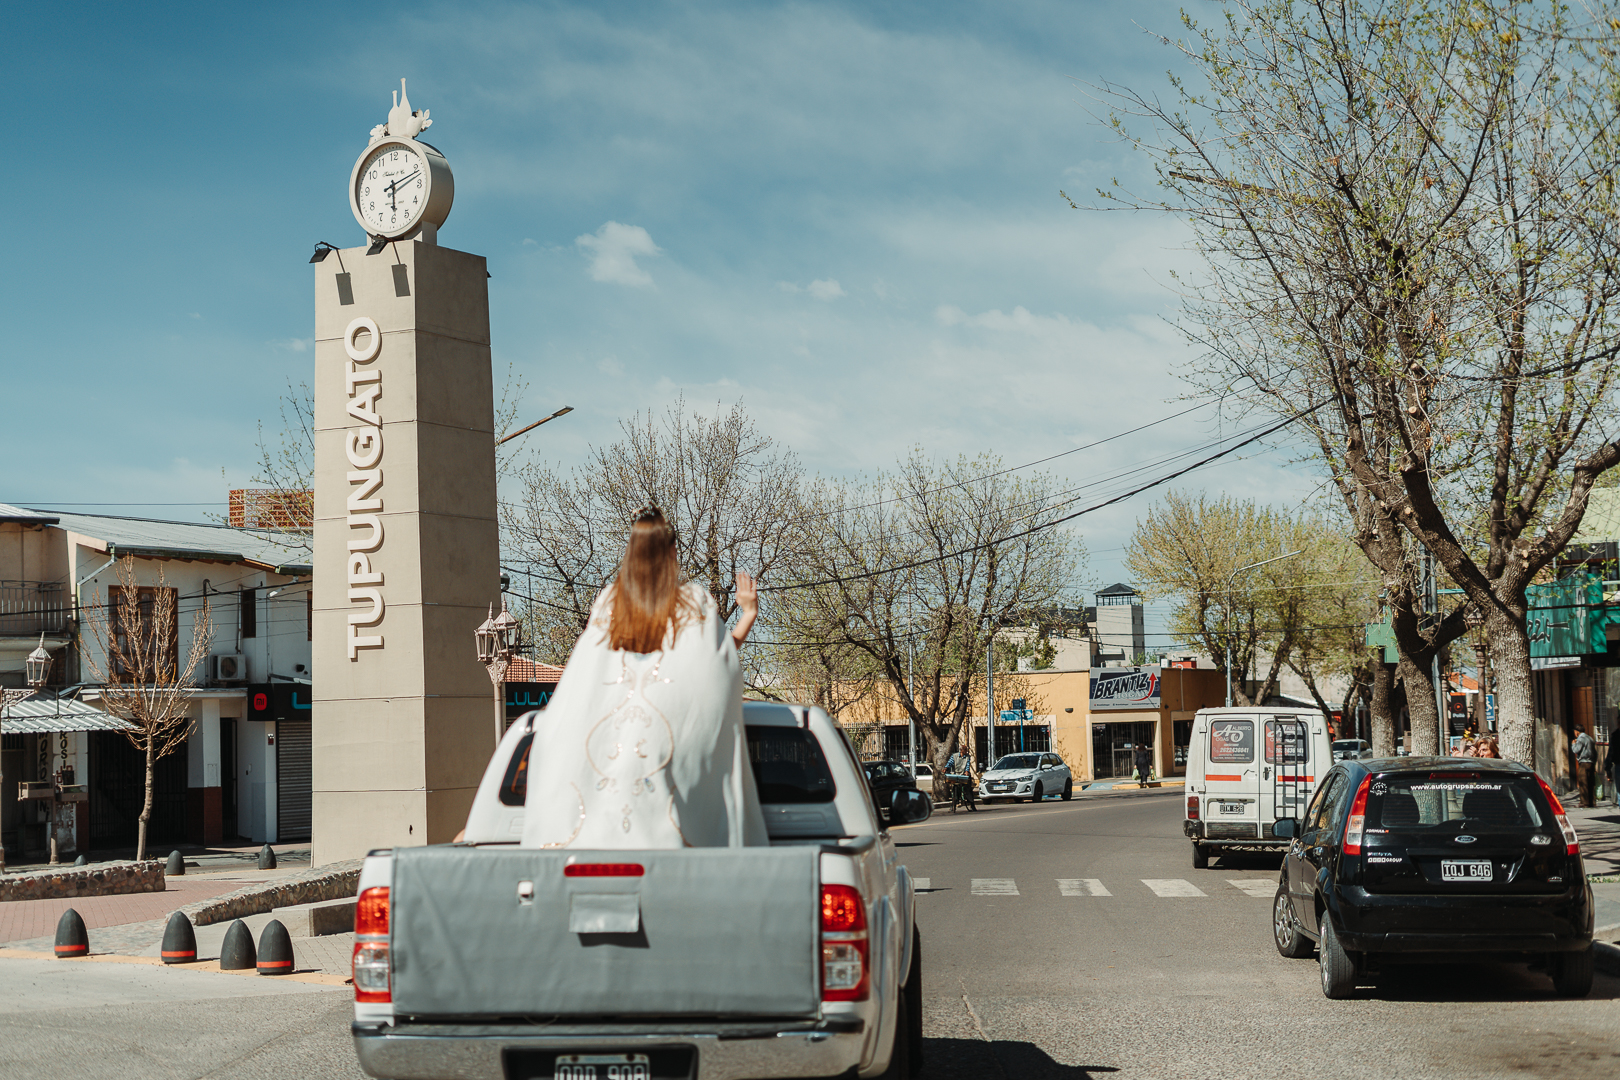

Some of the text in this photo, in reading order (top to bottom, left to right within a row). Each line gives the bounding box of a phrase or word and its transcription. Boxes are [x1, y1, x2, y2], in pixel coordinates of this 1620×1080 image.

[390, 152, 398, 161] 12
[378, 158, 385, 167] 11
[368, 170, 378, 180] 10
[416, 179, 422, 188] 3
[365, 186, 371, 196] 9
[412, 195, 418, 205] 4
[369, 201, 375, 211] 8
[378, 212, 384, 222] 7
[391, 213, 397, 223] 6
[404, 209, 410, 218] 5
[344, 317, 385, 662] TUPUNGATO
[1410, 783, 1502, 791] www.autogrupsa.com.ar
[1469, 864, 1491, 877] 646
